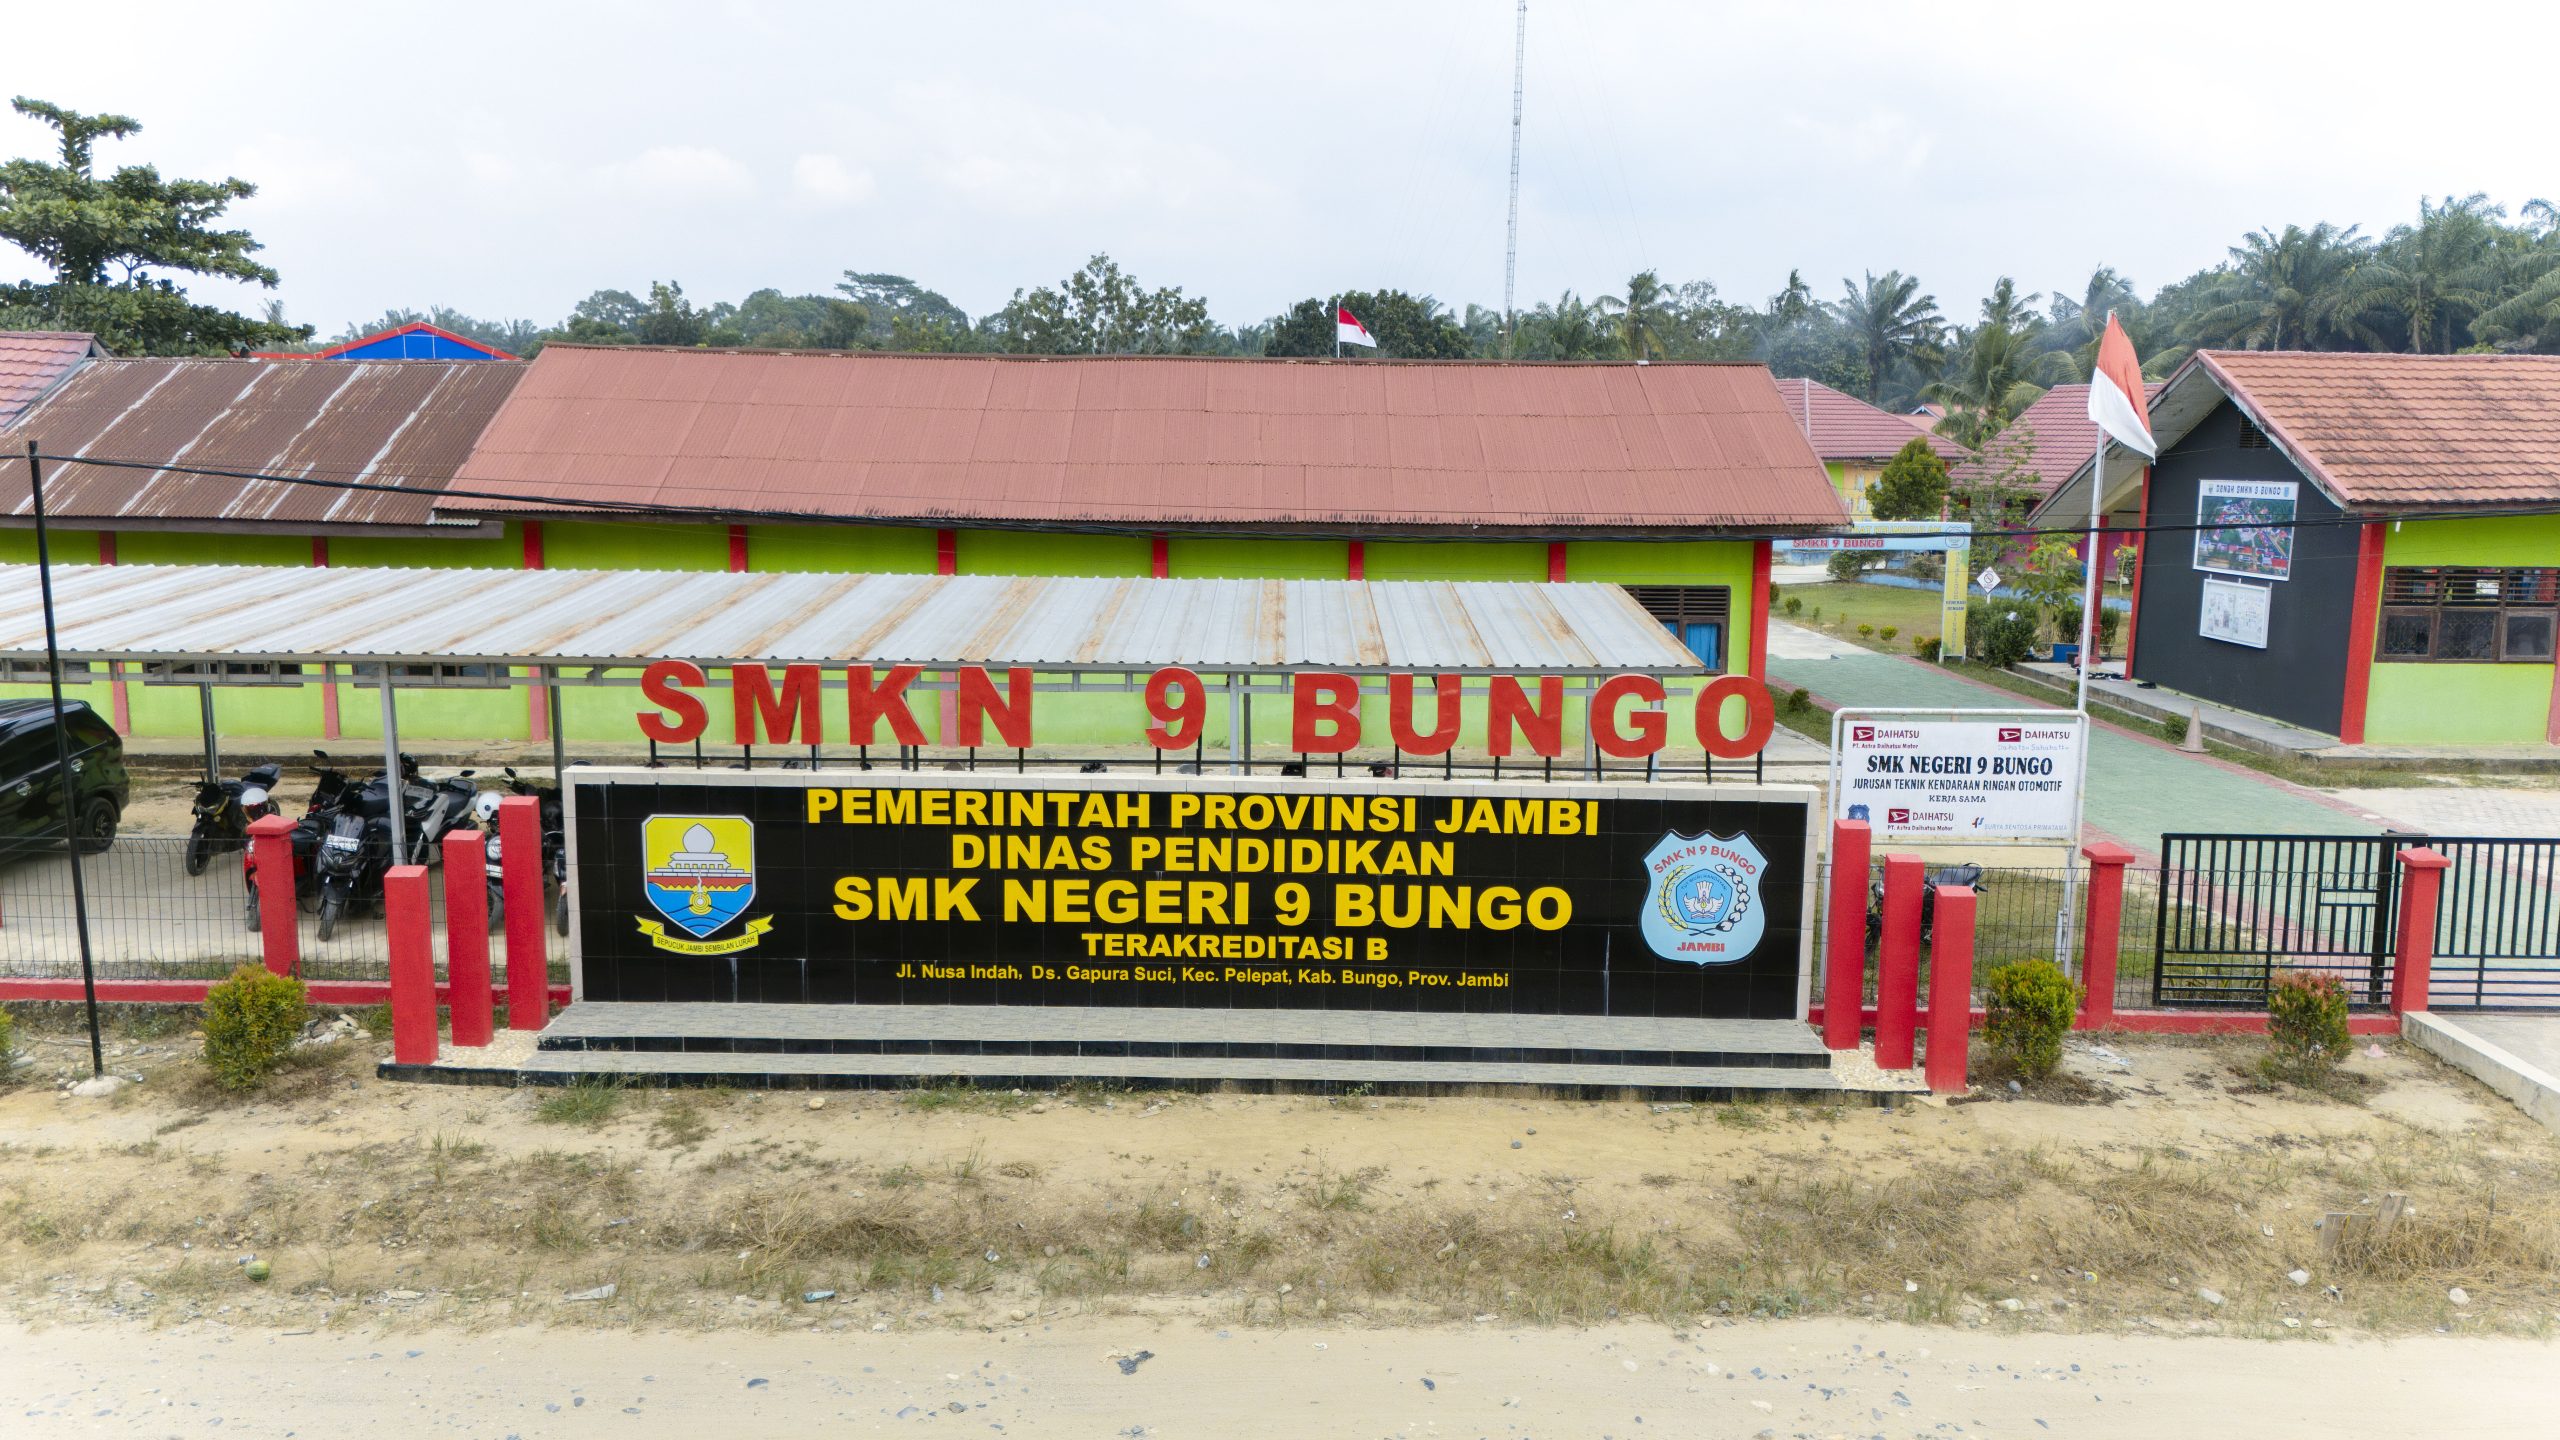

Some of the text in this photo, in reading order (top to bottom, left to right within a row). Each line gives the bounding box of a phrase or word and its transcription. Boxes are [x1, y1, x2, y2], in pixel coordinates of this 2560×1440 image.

[1792, 538, 1884, 549] SMKN 9 BUNGO
[637, 660, 1775, 758] SMKN 9 BUNGO
[1878, 729, 1920, 739] DAIHATSU
[2024, 730, 2070, 740] DAIHATSU
[1867, 755, 2053, 776] SMK NEGERI 9 BUNGO
[1853, 778, 2062, 792] JURUSAN TEKNIK KENDARAAN RINGAN OTOMOTIF
[1929, 795, 1957, 803] KERJA
[808, 789, 1599, 836] PEMERINTAH PROVINSI JAMBI
[1912, 812, 1954, 822] DAIHATSU
[952, 834, 1455, 876] DINAS PENDIDIKAN
[1654, 845, 1757, 876] SMK N 9 BUNGO
[833, 876, 1573, 931] SMK NEGERI 9 BUNGO
[656, 935, 755, 952] SEPUCUK JAMBI SEMBILAN LURAH
[1082, 933, 1389, 961] TERAKREDITASI B
[1676, 942, 1725, 952] JAMBI
[896, 964, 1509, 988] Jl. Nusa Indah, Ds. Gapura Suci, Kec. Pelepat, Kab. Bungo, Prov. Jambi
